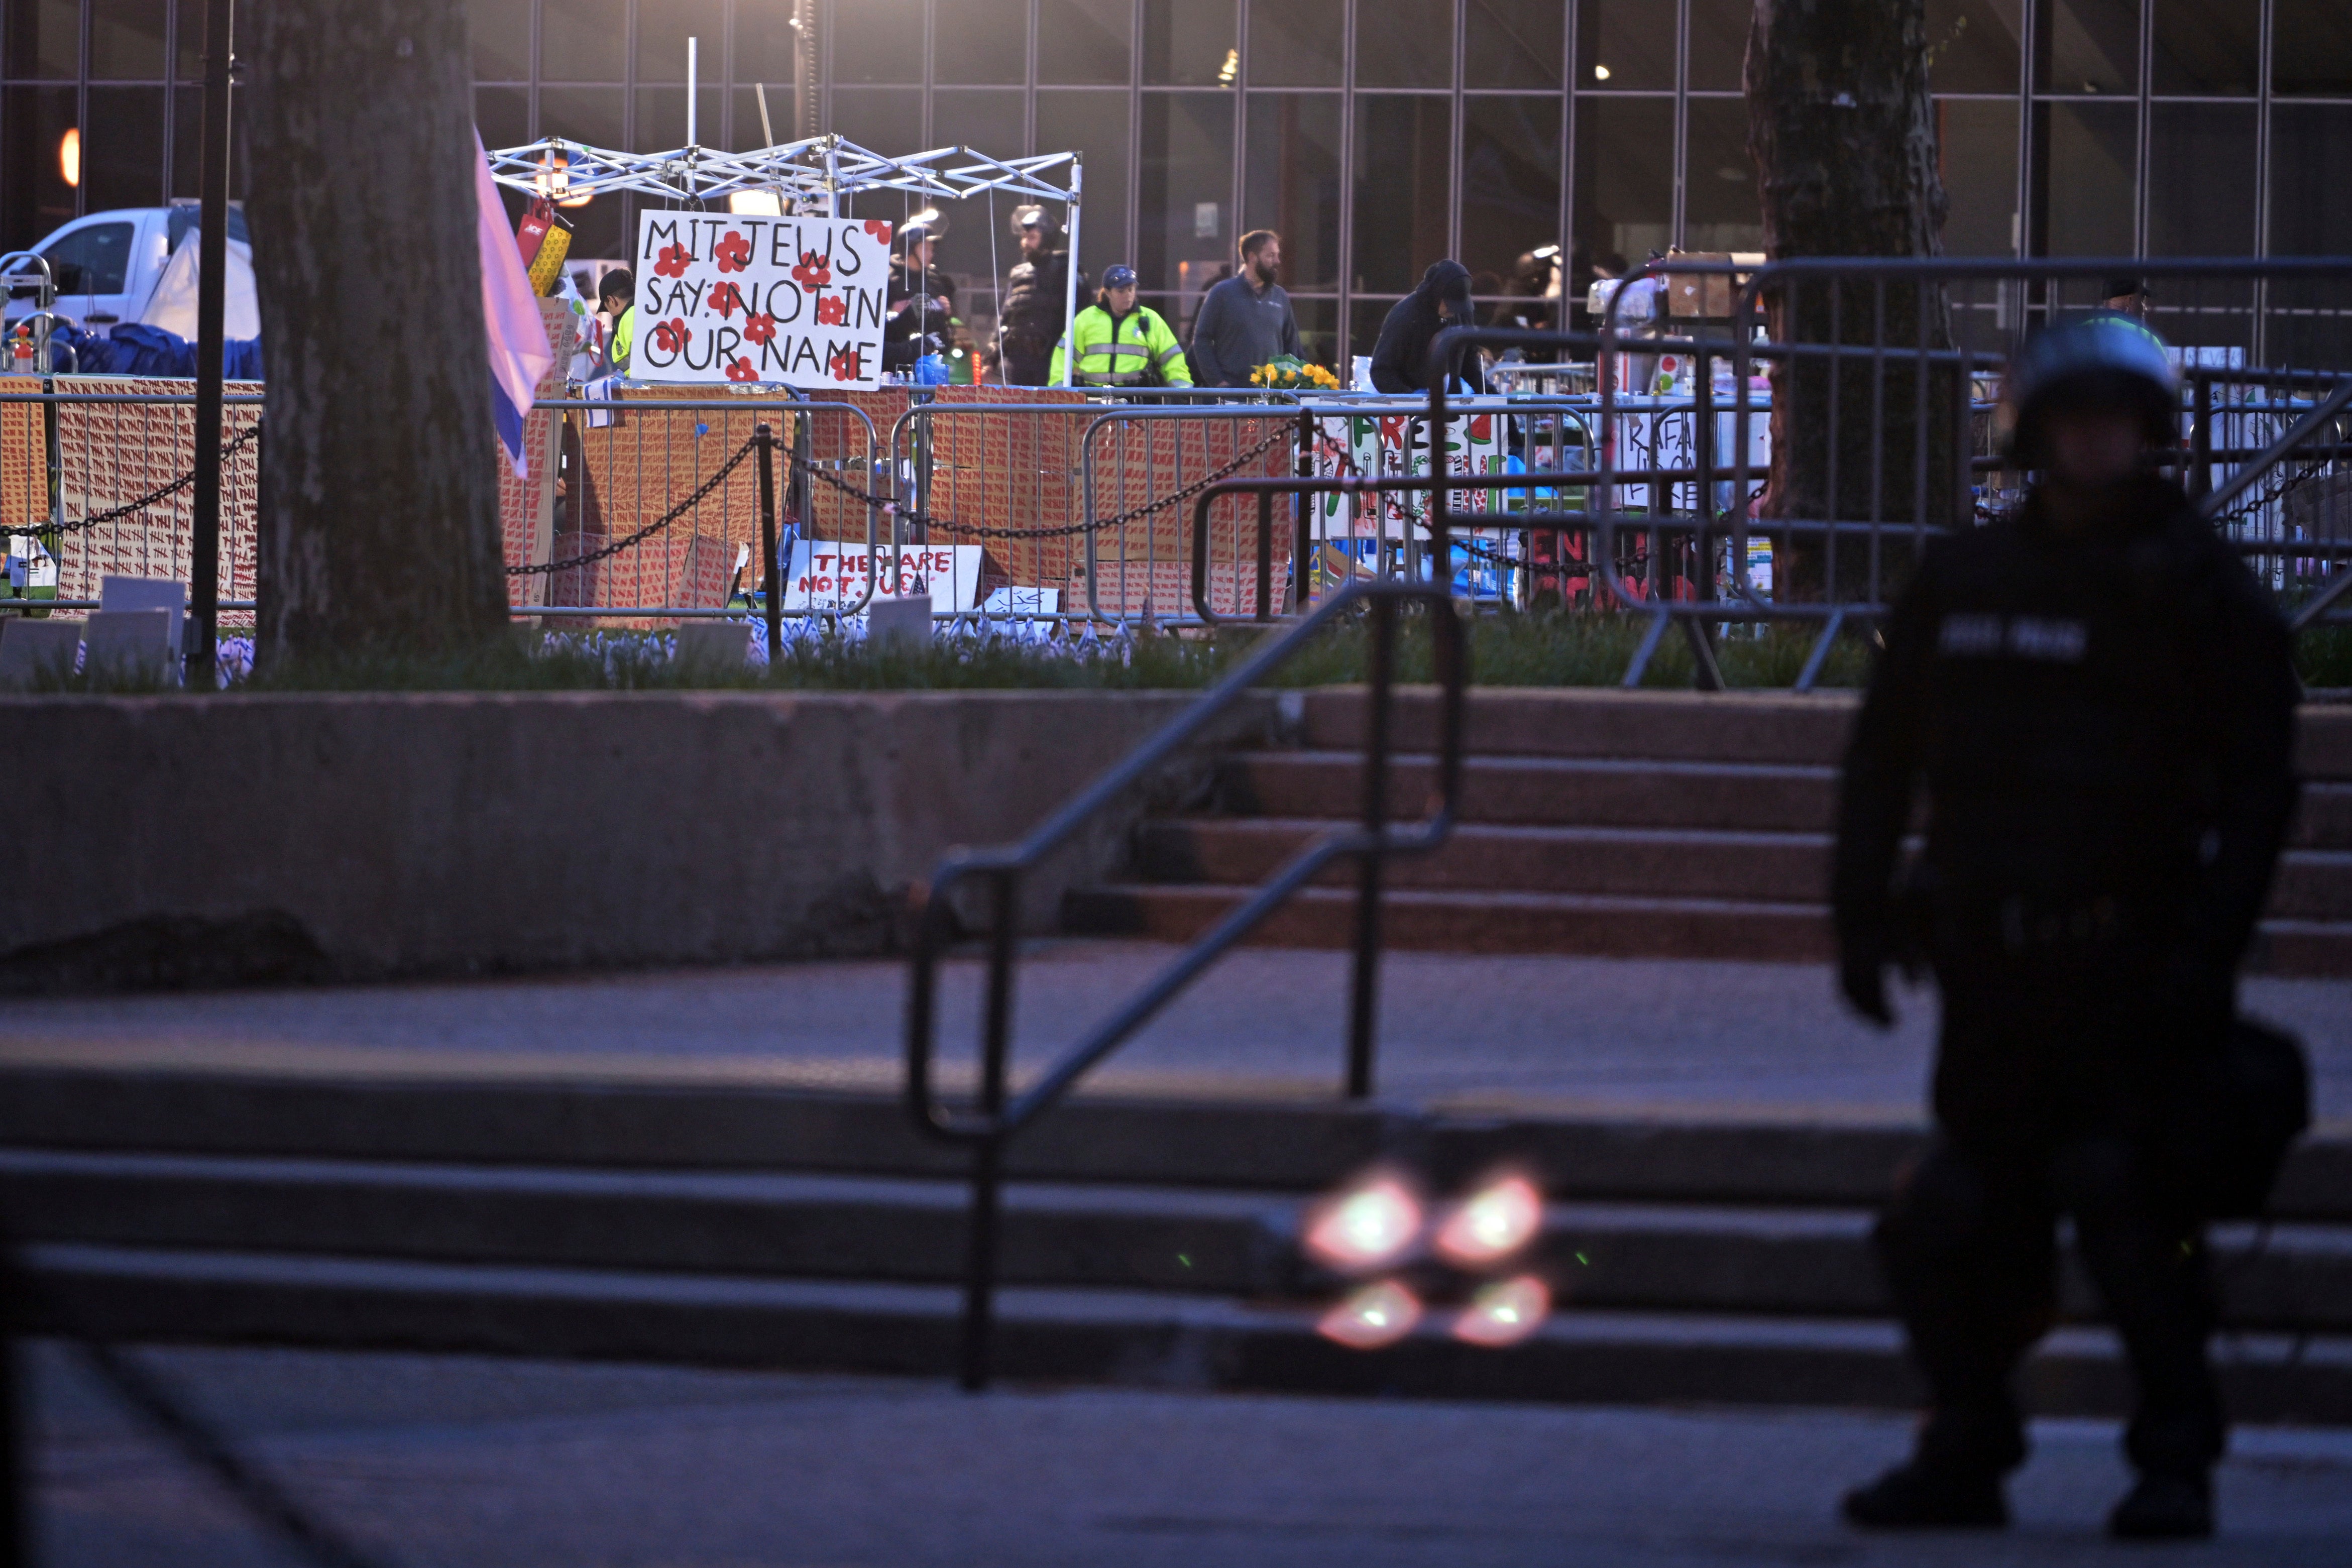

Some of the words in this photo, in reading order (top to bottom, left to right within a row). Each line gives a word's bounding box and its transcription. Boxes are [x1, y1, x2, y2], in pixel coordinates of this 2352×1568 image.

[524, 223, 543, 235] ACE
[644, 219, 728, 262] MIT
[733, 221, 860, 276] JEWS
[644, 277, 713, 317] SAY:
[724, 280, 832, 325] NOT
[839, 285, 882, 329] IN
[644, 325, 741, 370] OUR
[761, 334, 876, 382] NAME
[1629, 419, 1697, 452] RAFA
[814, 553, 893, 572] THEY
[900, 551, 953, 573] ARE
[799, 575, 855, 597] NOT
